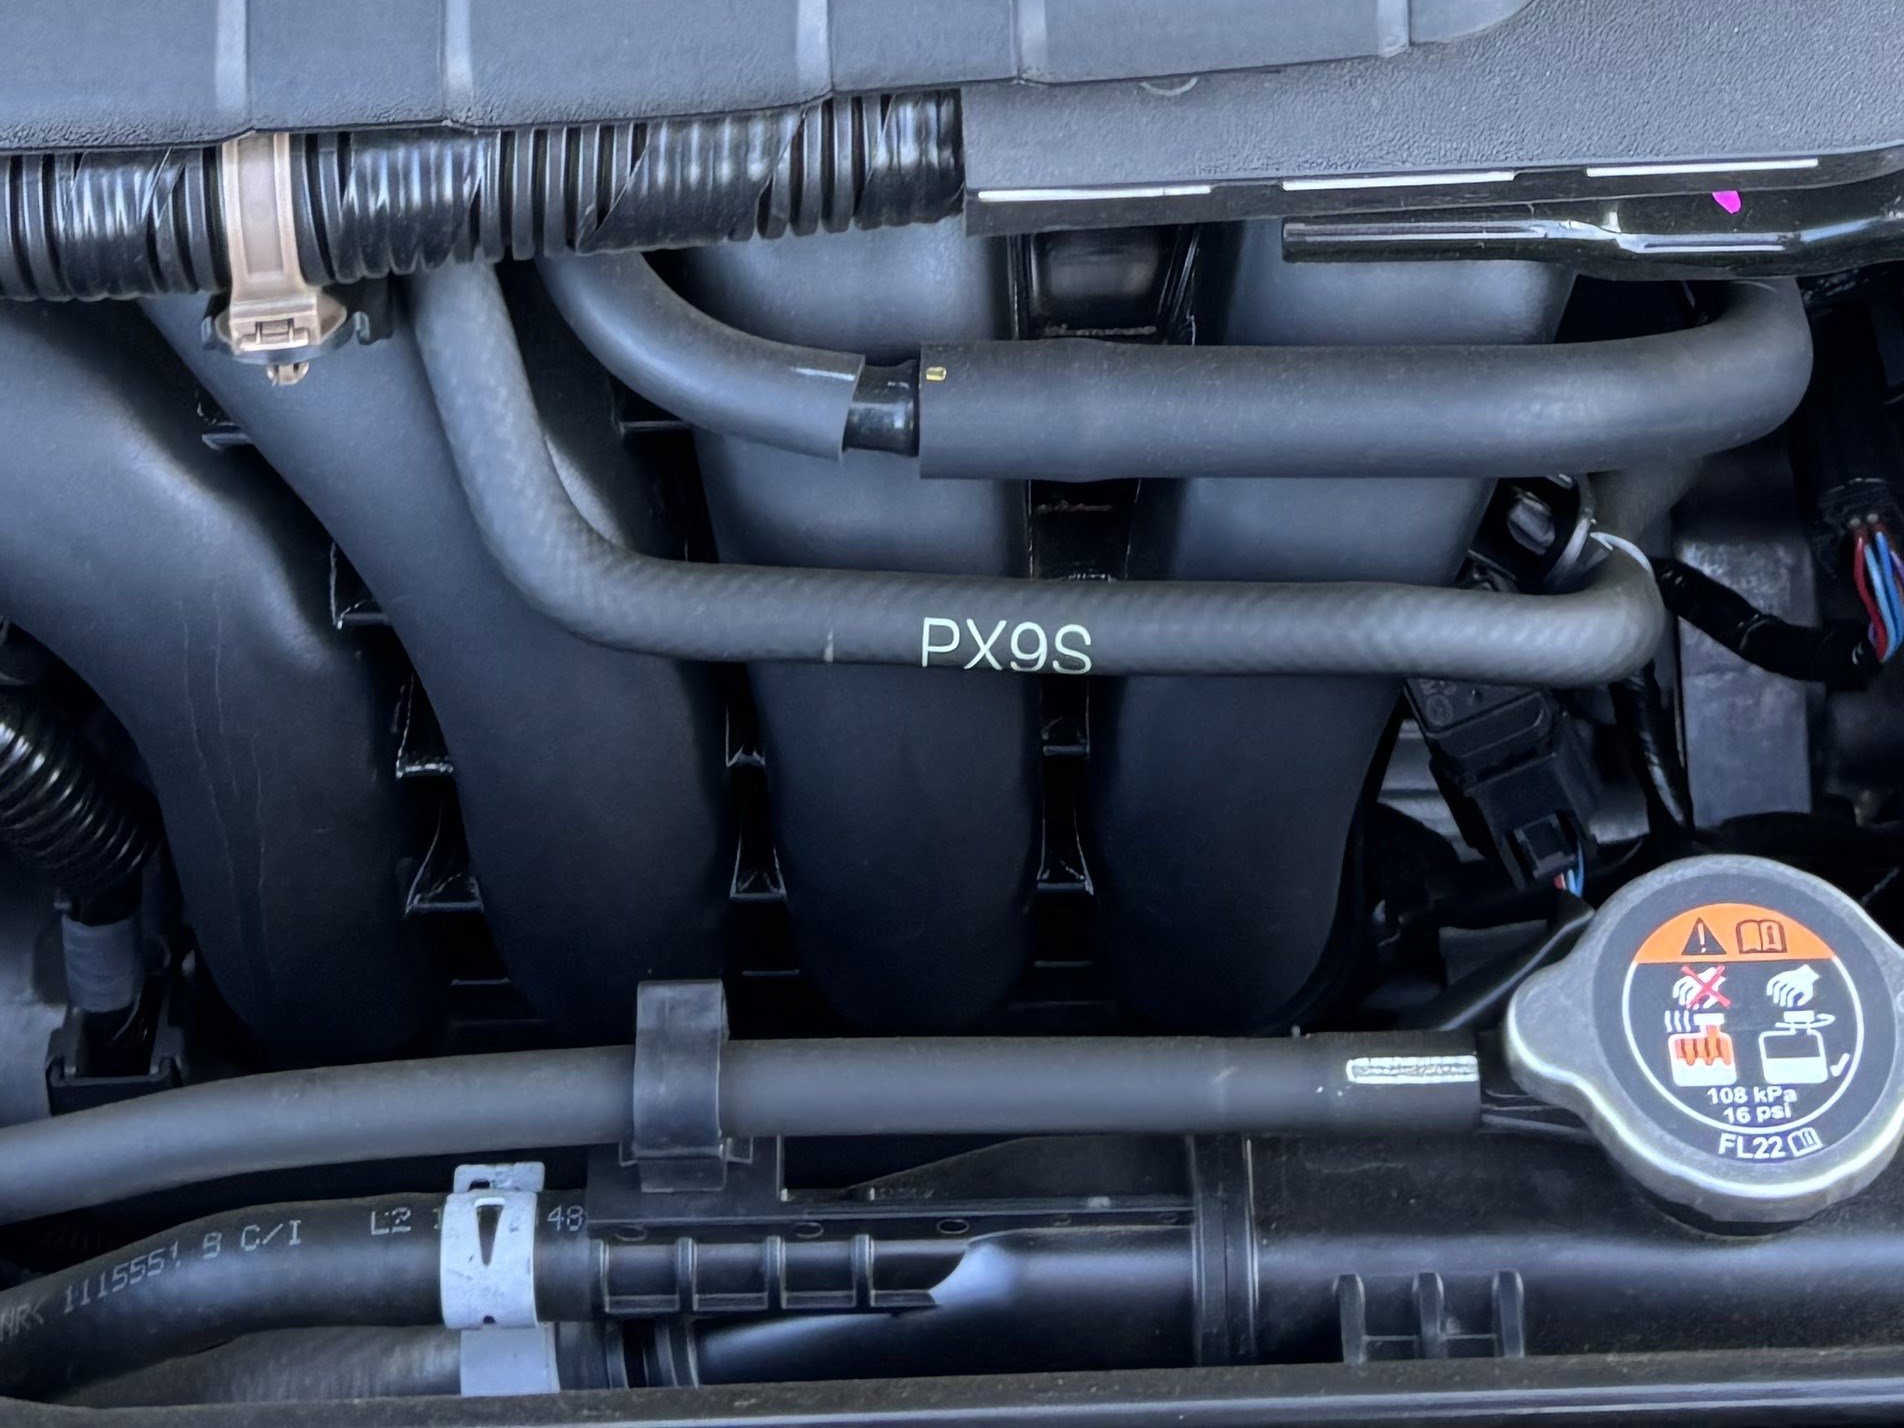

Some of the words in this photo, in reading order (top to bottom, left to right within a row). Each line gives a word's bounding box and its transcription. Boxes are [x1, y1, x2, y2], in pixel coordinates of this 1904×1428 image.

[921, 616, 1093, 676] PX9S
[1707, 1086, 1749, 1104] 108
[1753, 1085, 1798, 1103] kPa
[1723, 1106, 1752, 1124] 16
[1756, 1102, 1792, 1123] psi
[1718, 1132, 1787, 1159] FL22
